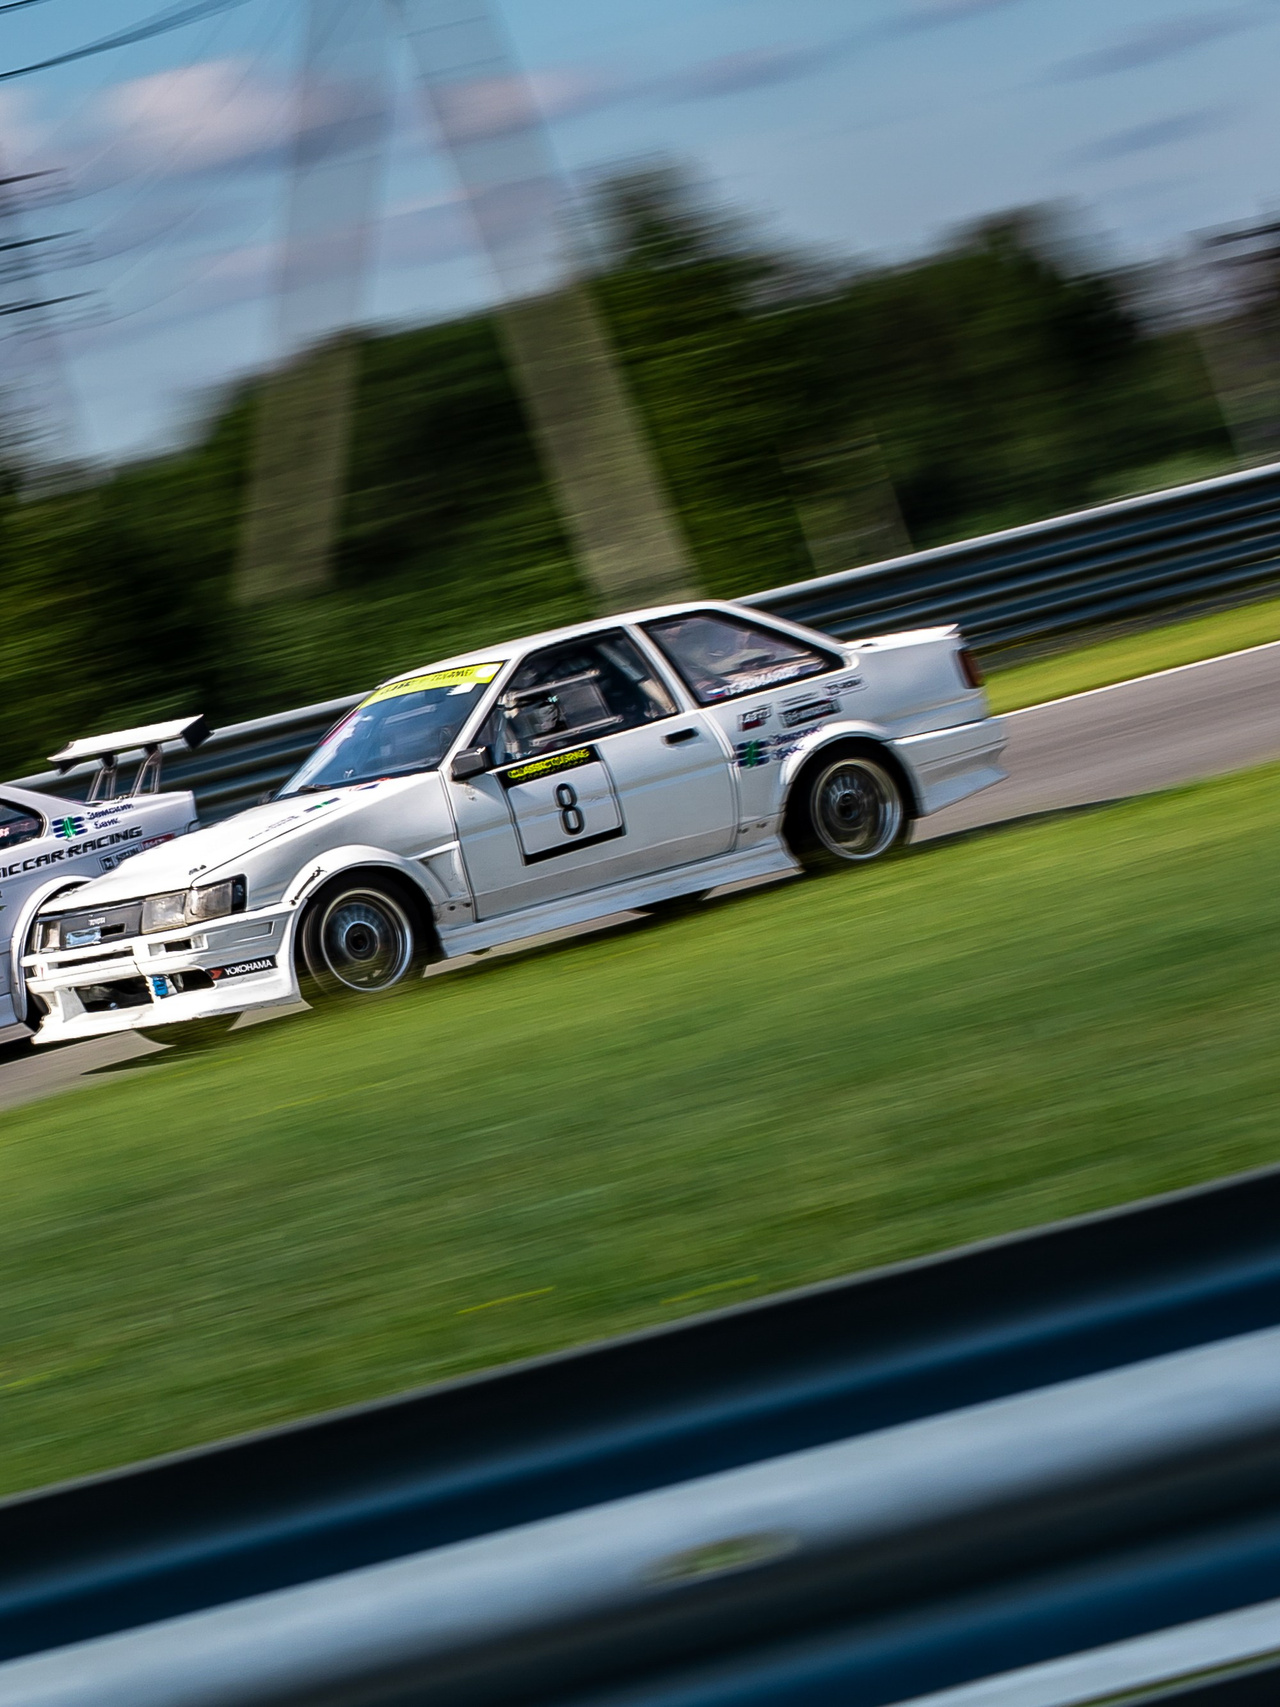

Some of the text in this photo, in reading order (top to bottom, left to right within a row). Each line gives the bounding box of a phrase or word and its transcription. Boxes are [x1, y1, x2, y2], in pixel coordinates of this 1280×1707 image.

[554, 783, 585, 835] 8
[66, 825, 143, 857] RACING
[224, 959, 273, 975] YOKOHAMA
